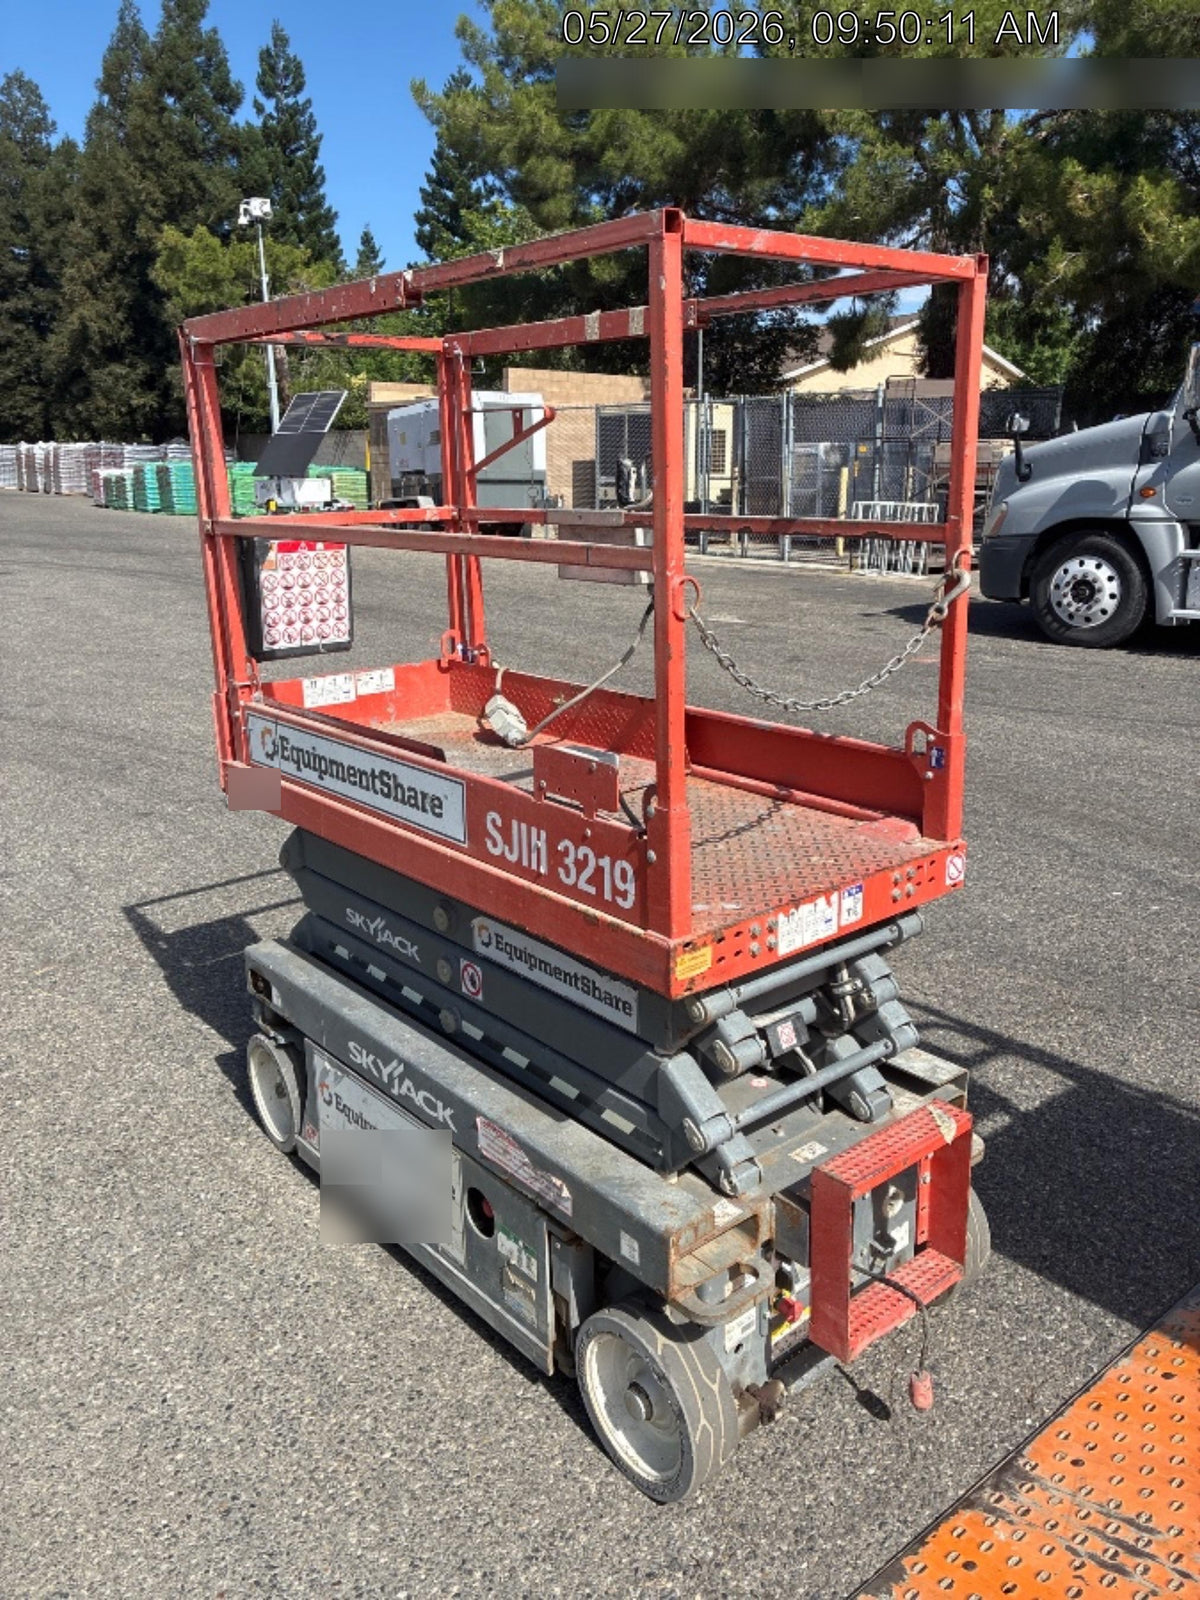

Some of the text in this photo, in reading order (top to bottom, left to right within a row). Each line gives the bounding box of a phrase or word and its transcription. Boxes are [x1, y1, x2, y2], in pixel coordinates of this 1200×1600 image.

[279, 735, 443, 818] EquipmentShare
[557, 838, 636, 909] 3219
[346, 908, 420, 963] SKYJACK
[494, 933, 633, 1017] EquipmentShare
[348, 1042, 457, 1133] SKYJACK
